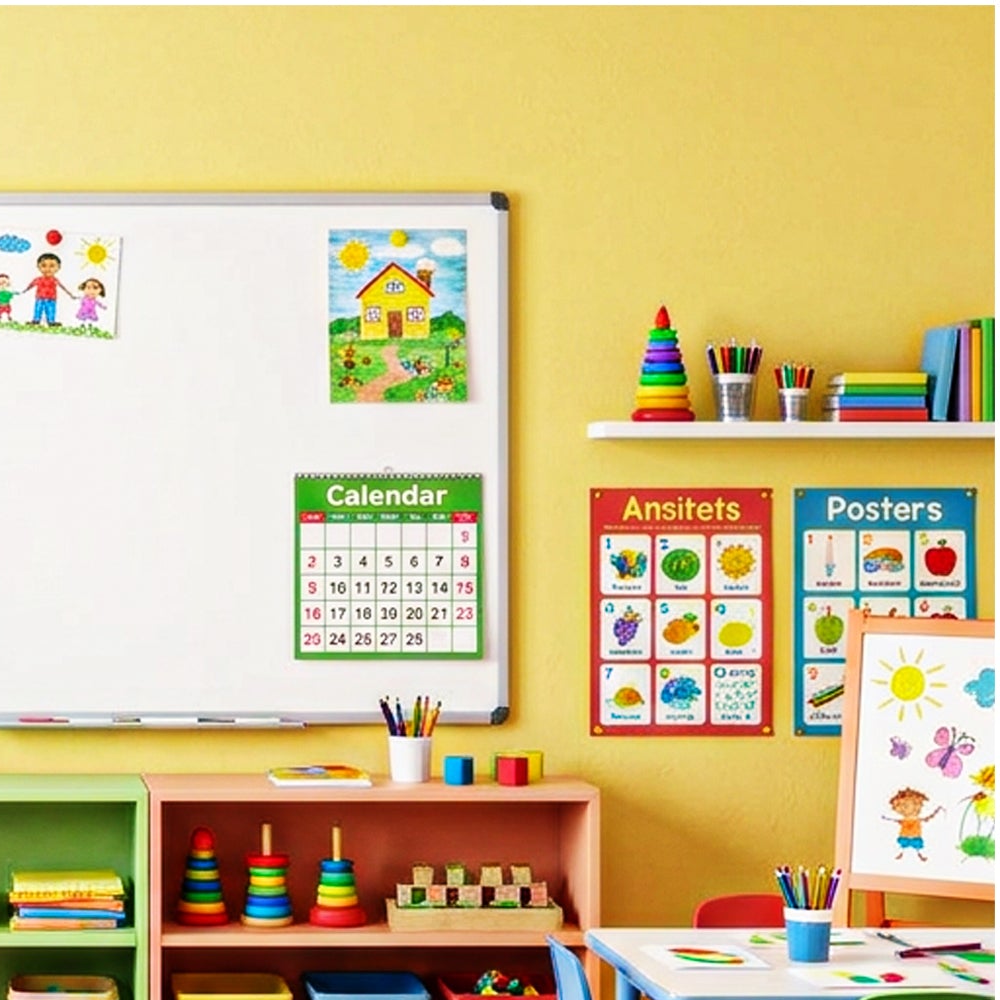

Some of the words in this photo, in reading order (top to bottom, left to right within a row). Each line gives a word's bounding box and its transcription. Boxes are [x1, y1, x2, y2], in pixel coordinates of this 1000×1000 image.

[326, 484, 448, 506] Calendar
[622, 495, 741, 521] Ansitets
[827, 496, 943, 522] Posters
[307, 555, 317, 568] 2
[333, 555, 343, 568] 3
[359, 555, 368, 568] 4
[384, 555, 394, 568] 5
[409, 555, 419, 568] 6
[435, 554, 444, 567] 7
[355, 581, 371, 594] 11
[406, 581, 423, 594] 13
[432, 581, 449, 594] 14
[304, 606, 321, 620] 16
[330, 606, 347, 620] 17
[356, 606, 372, 620] 18
[405, 606, 423, 620] 20
[430, 606, 448, 620] 21
[329, 632, 347, 646] 24
[380, 632, 398, 646] 27
